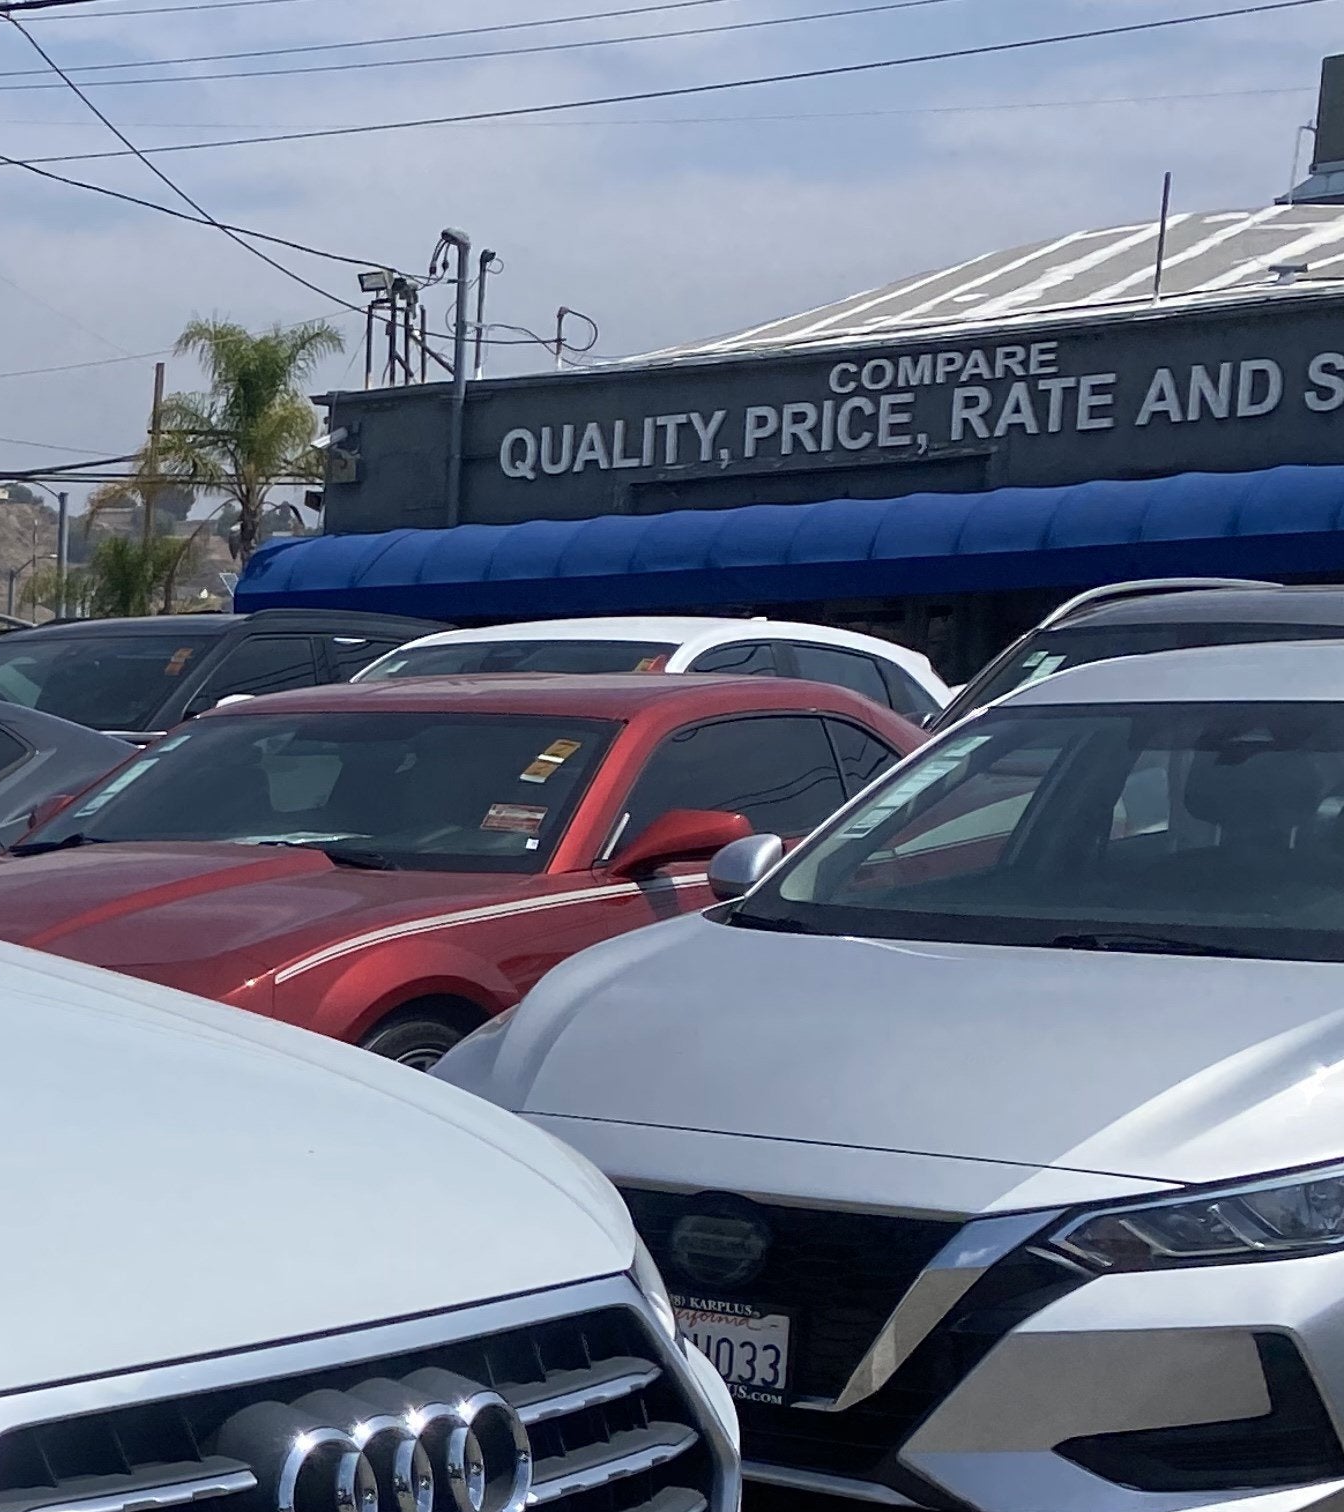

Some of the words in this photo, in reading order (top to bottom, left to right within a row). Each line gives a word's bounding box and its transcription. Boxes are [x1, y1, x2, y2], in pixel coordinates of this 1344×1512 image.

[828, 341, 1059, 393] COMPARE
[500, 410, 730, 480] QUALITY,
[744, 392, 928, 455] PRICE,
[950, 373, 1117, 441] RATE
[1134, 358, 1284, 426] AND
[689, 1297, 753, 1317] KARPLUS
